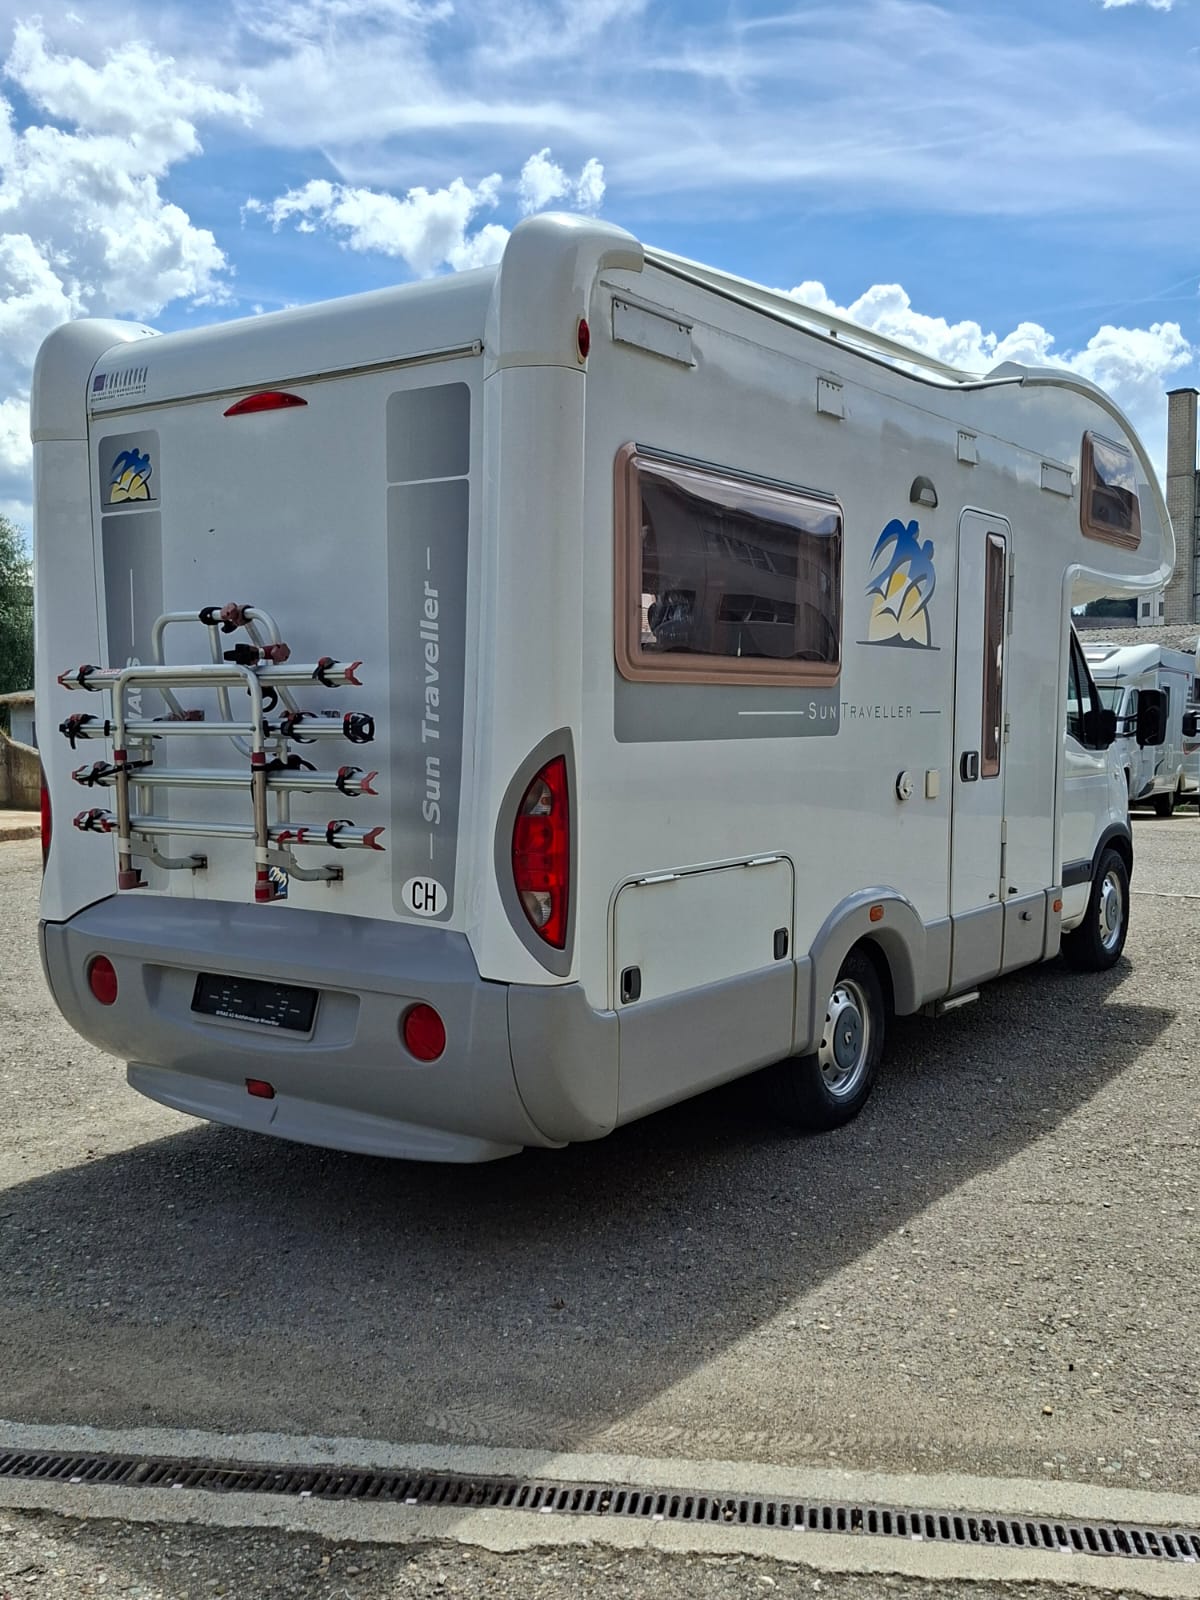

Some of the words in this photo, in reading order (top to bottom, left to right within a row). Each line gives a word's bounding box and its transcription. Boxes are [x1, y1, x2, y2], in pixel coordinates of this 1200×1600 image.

[419, 580, 440, 743] Traveller
[422, 756, 441, 825] Sun
[411, 881, 437, 912] CH
